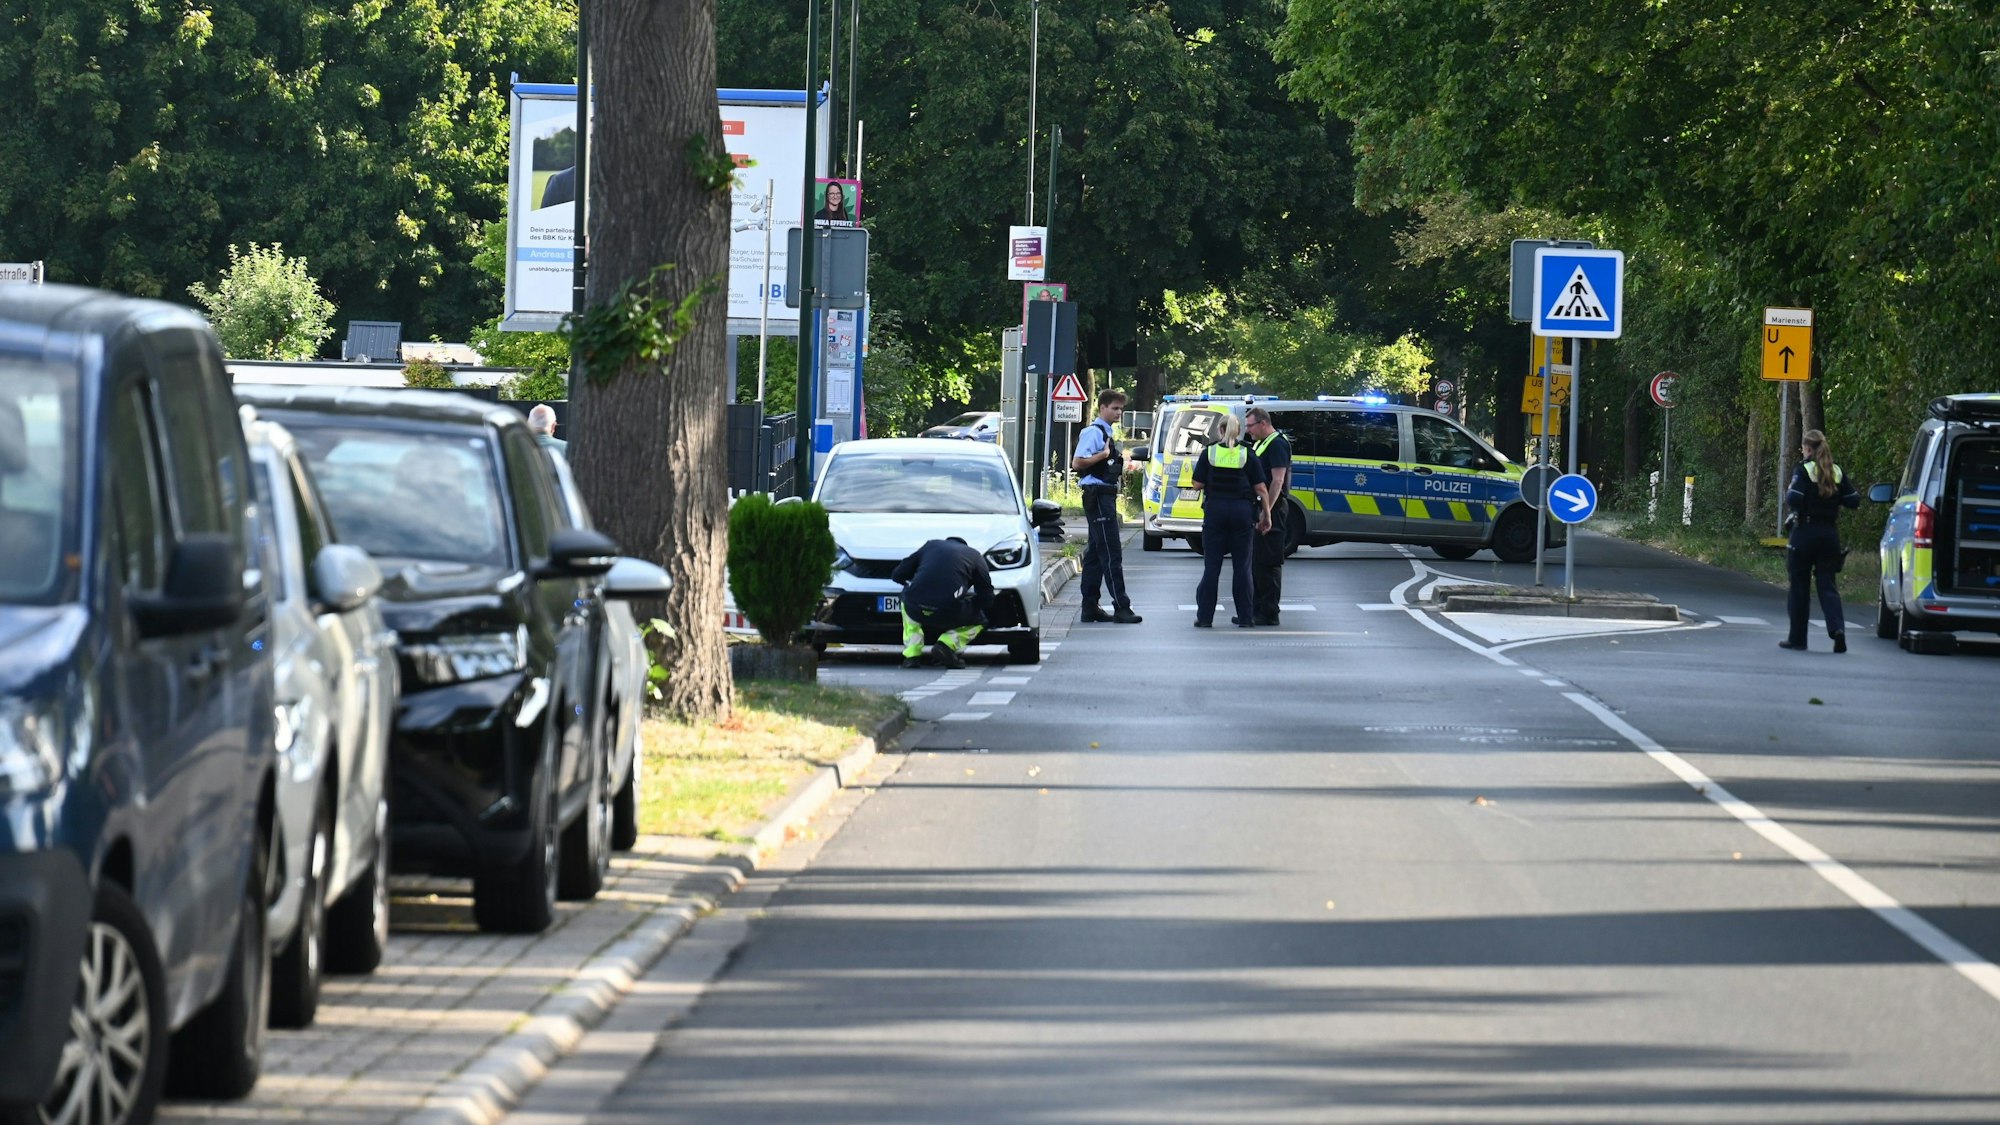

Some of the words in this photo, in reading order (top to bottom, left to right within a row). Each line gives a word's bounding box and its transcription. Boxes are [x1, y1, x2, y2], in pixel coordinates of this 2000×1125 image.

[529, 249, 565, 259] Andreas
[1771, 316, 1808, 325] Marienstr.
[1767, 328, 1779, 344] U
[1531, 379, 1543, 388] U3
[1551, 376, 1559, 385] U
[1056, 404, 1078, 412] Radweg-
[1424, 479, 1472, 494] POLIZEI
[885, 598, 902, 610] BM
